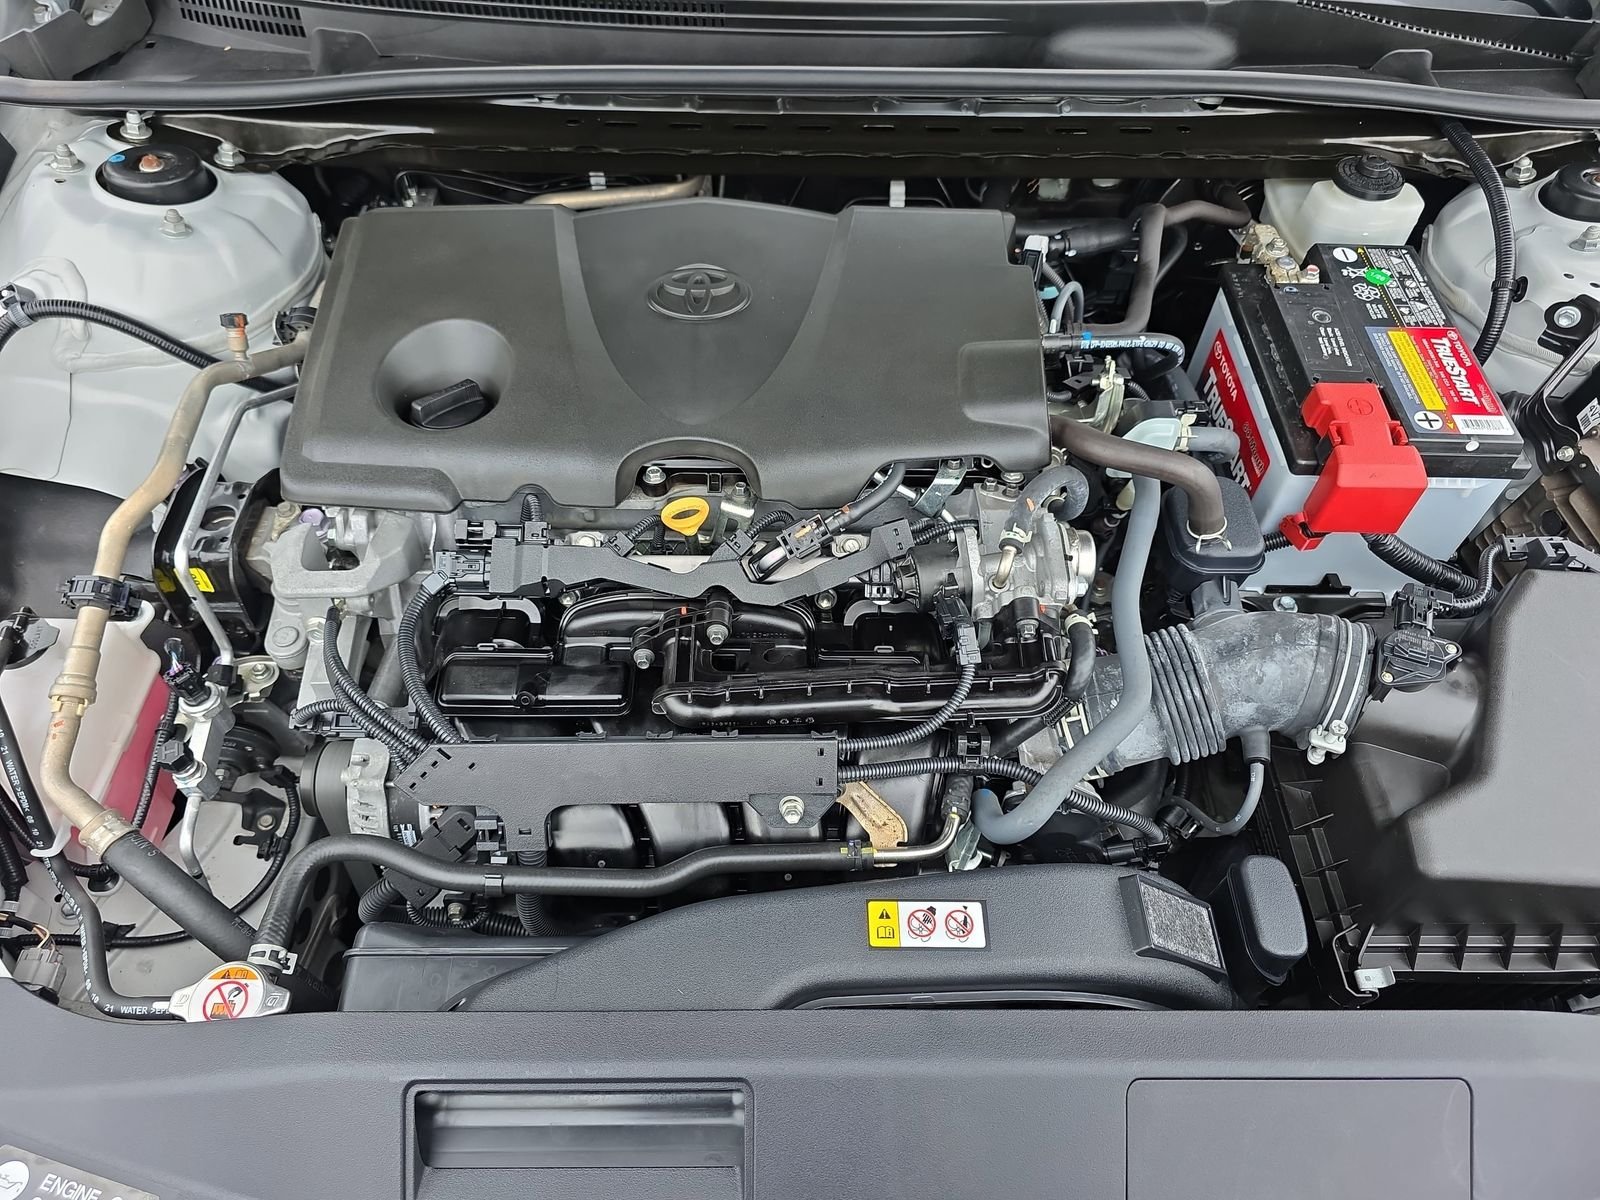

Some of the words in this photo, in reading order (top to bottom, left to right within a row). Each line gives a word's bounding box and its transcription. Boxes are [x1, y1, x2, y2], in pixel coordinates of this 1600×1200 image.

[1453, 340, 1472, 367] TOYOTA
[1220, 354, 1238, 402] TOYOTA
[5, 759, 20, 787] WATER
[91, 993, 99, 1004] 10
[103, 1003, 115, 1013] 21
[120, 1005, 148, 1015] WATER
